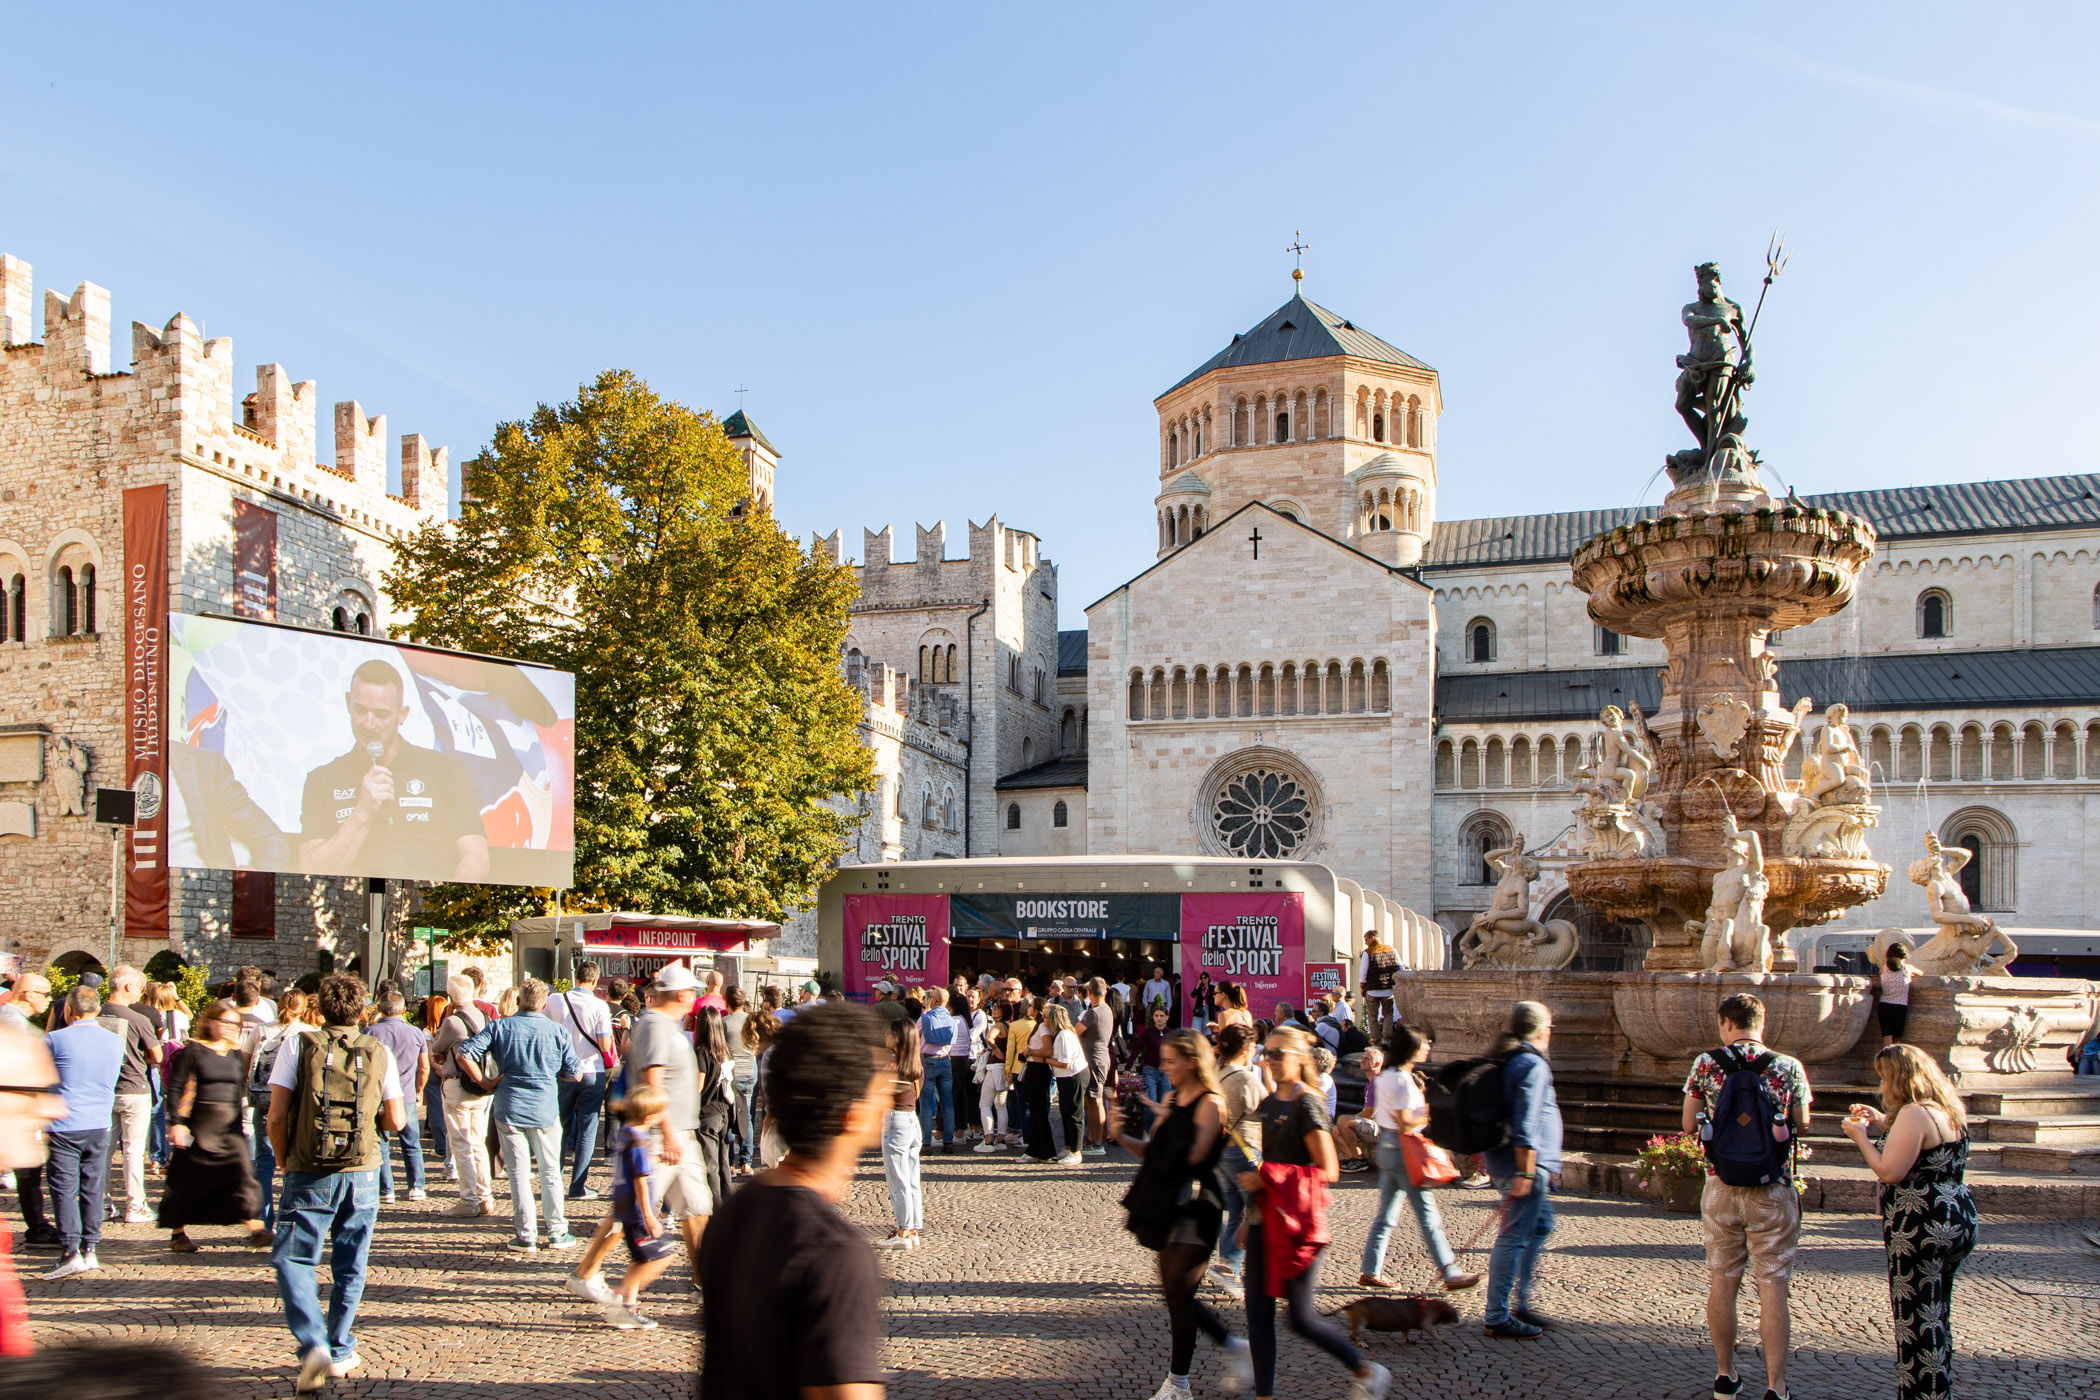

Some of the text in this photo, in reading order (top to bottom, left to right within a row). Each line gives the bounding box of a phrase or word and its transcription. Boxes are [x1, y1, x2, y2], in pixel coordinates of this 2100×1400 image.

[133, 563, 148, 761] MUSEO DIOCESANO
[145, 627, 160, 757] TRIDENTINO
[333, 787, 356, 798] EA7
[406, 811, 429, 821] enel
[1016, 900, 1109, 919] BOOKSTORE
[890, 915, 926, 924] TRENTO
[1236, 916, 1279, 925] TRENTO
[638, 930, 697, 947] INFOPOINT
[861, 924, 930, 946] il FESTIVAL
[1201, 925, 1283, 949] il FESTIVAL
[611, 958, 630, 974] dello
[861, 946, 930, 970] dello SPORT
[1201, 949, 1283, 975] dello SPORT
[1313, 972, 1341, 981] FESTIVAL
